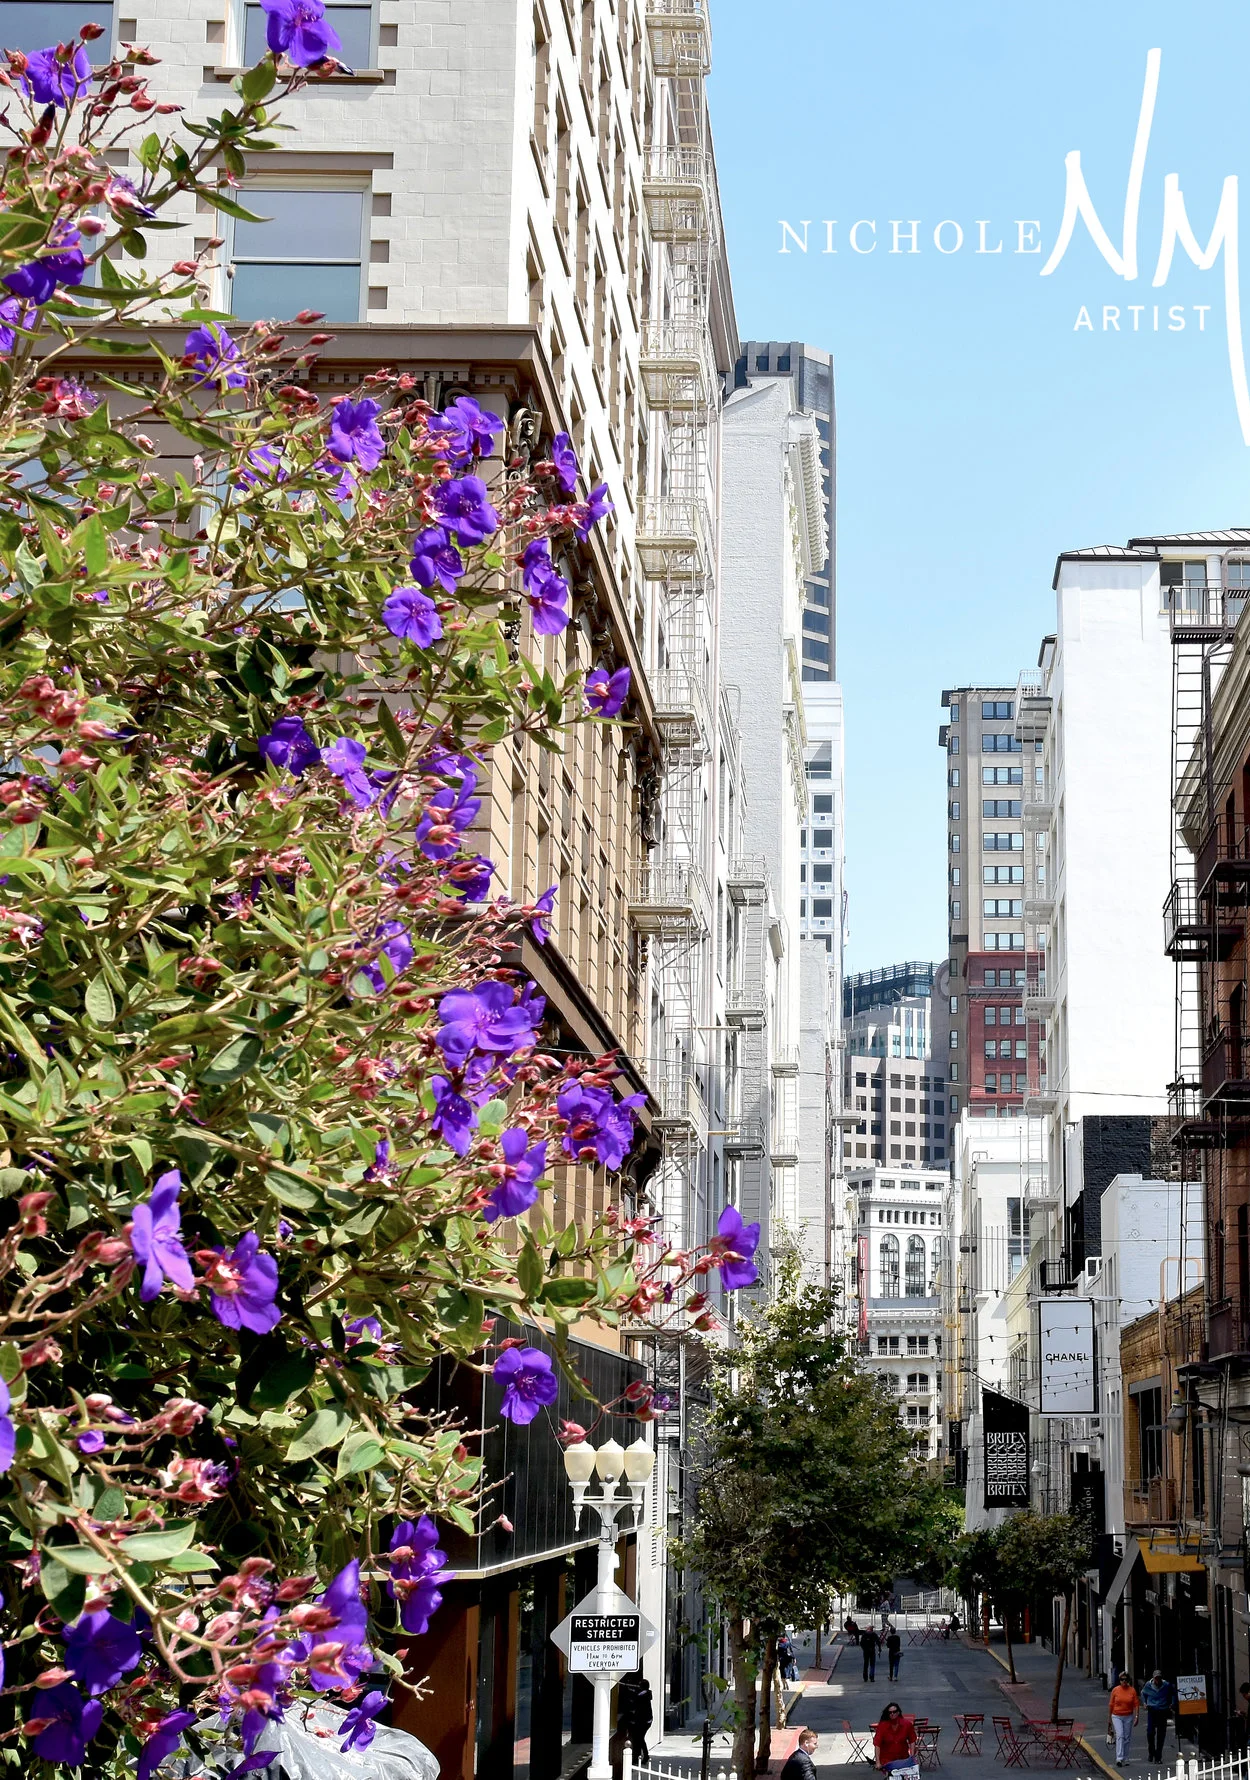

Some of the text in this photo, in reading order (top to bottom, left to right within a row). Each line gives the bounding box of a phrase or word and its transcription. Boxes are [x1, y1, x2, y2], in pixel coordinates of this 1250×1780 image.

[1045, 1353, 1089, 1361] CHANEL
[987, 1432, 1026, 1443] BRITEX
[987, 1484, 1027, 1496] BRITEX
[1083, 1487, 1094, 1509] john
[575, 1619, 635, 1627] RESTRICTED
[587, 1630, 623, 1638] STREET
